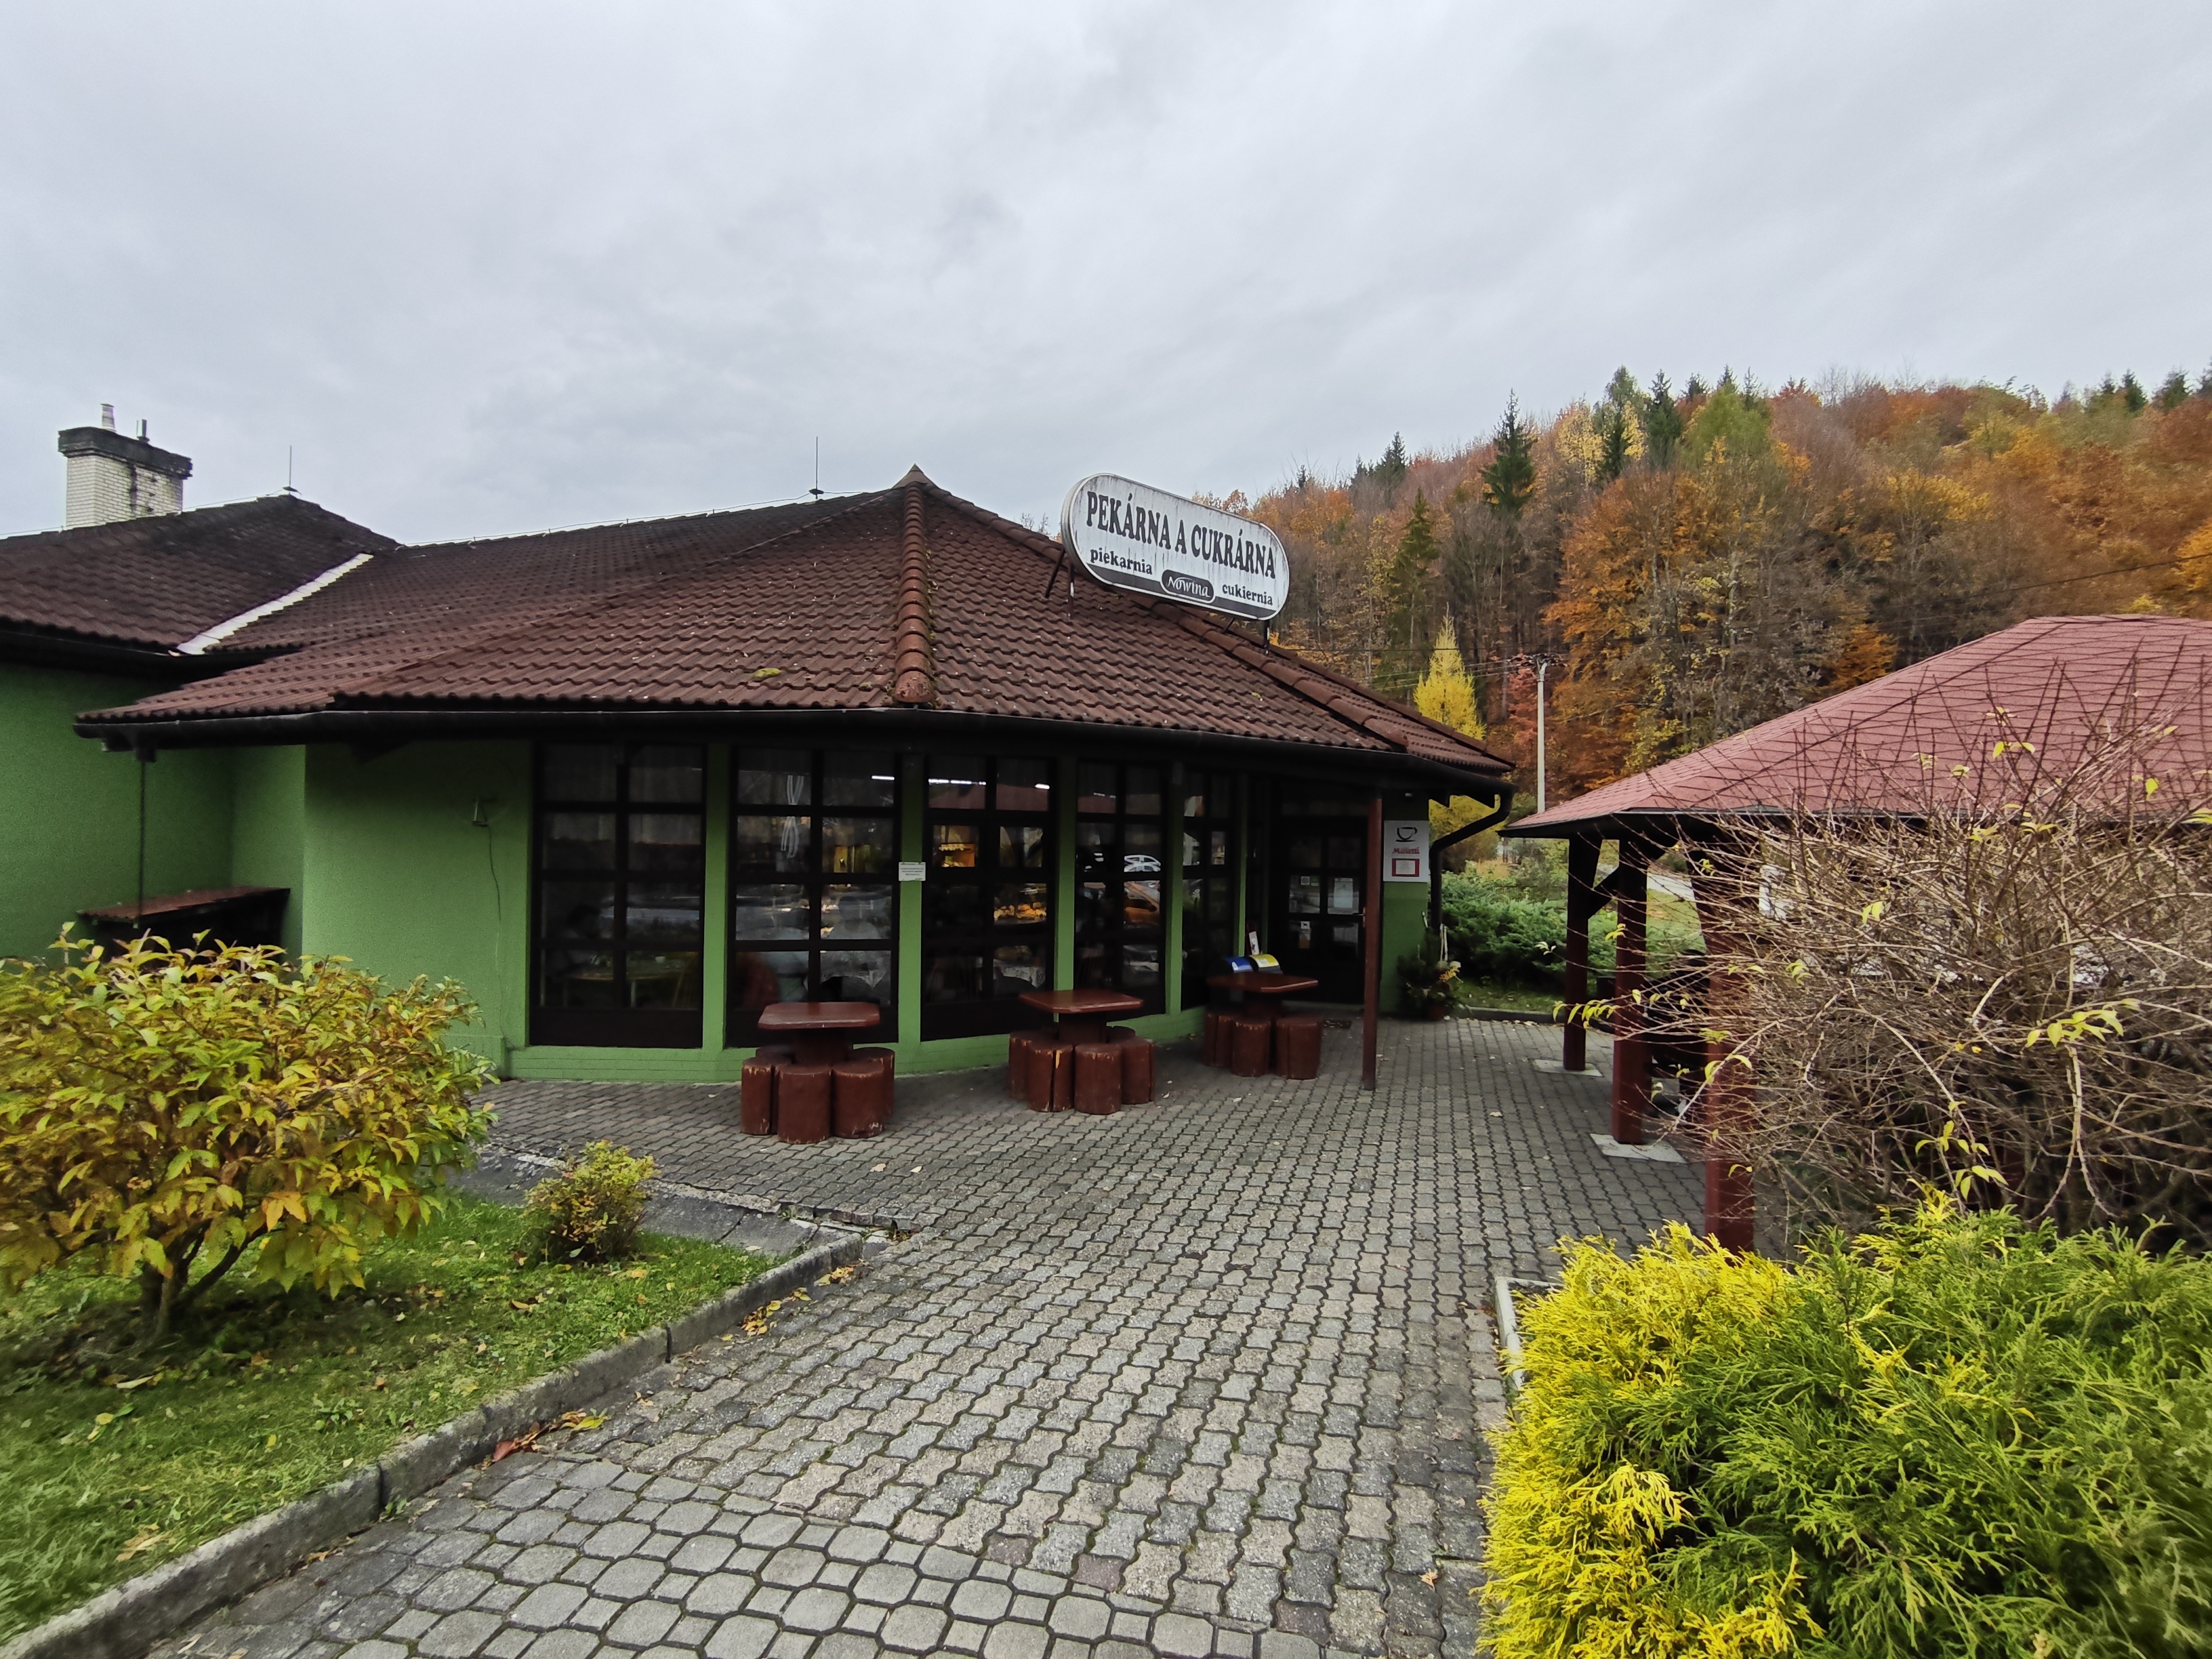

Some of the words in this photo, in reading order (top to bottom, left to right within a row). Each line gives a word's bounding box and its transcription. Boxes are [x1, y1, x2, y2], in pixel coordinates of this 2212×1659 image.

[1086, 491, 1171, 550] PEKÁRNA
[1175, 519, 1187, 554] A
[1191, 524, 1275, 579] CUKRÁRNA
[1090, 547, 1153, 575] piekarnia
[1222, 583, 1273, 606] cukiernia
[1166, 575, 1212, 598] Nowina
